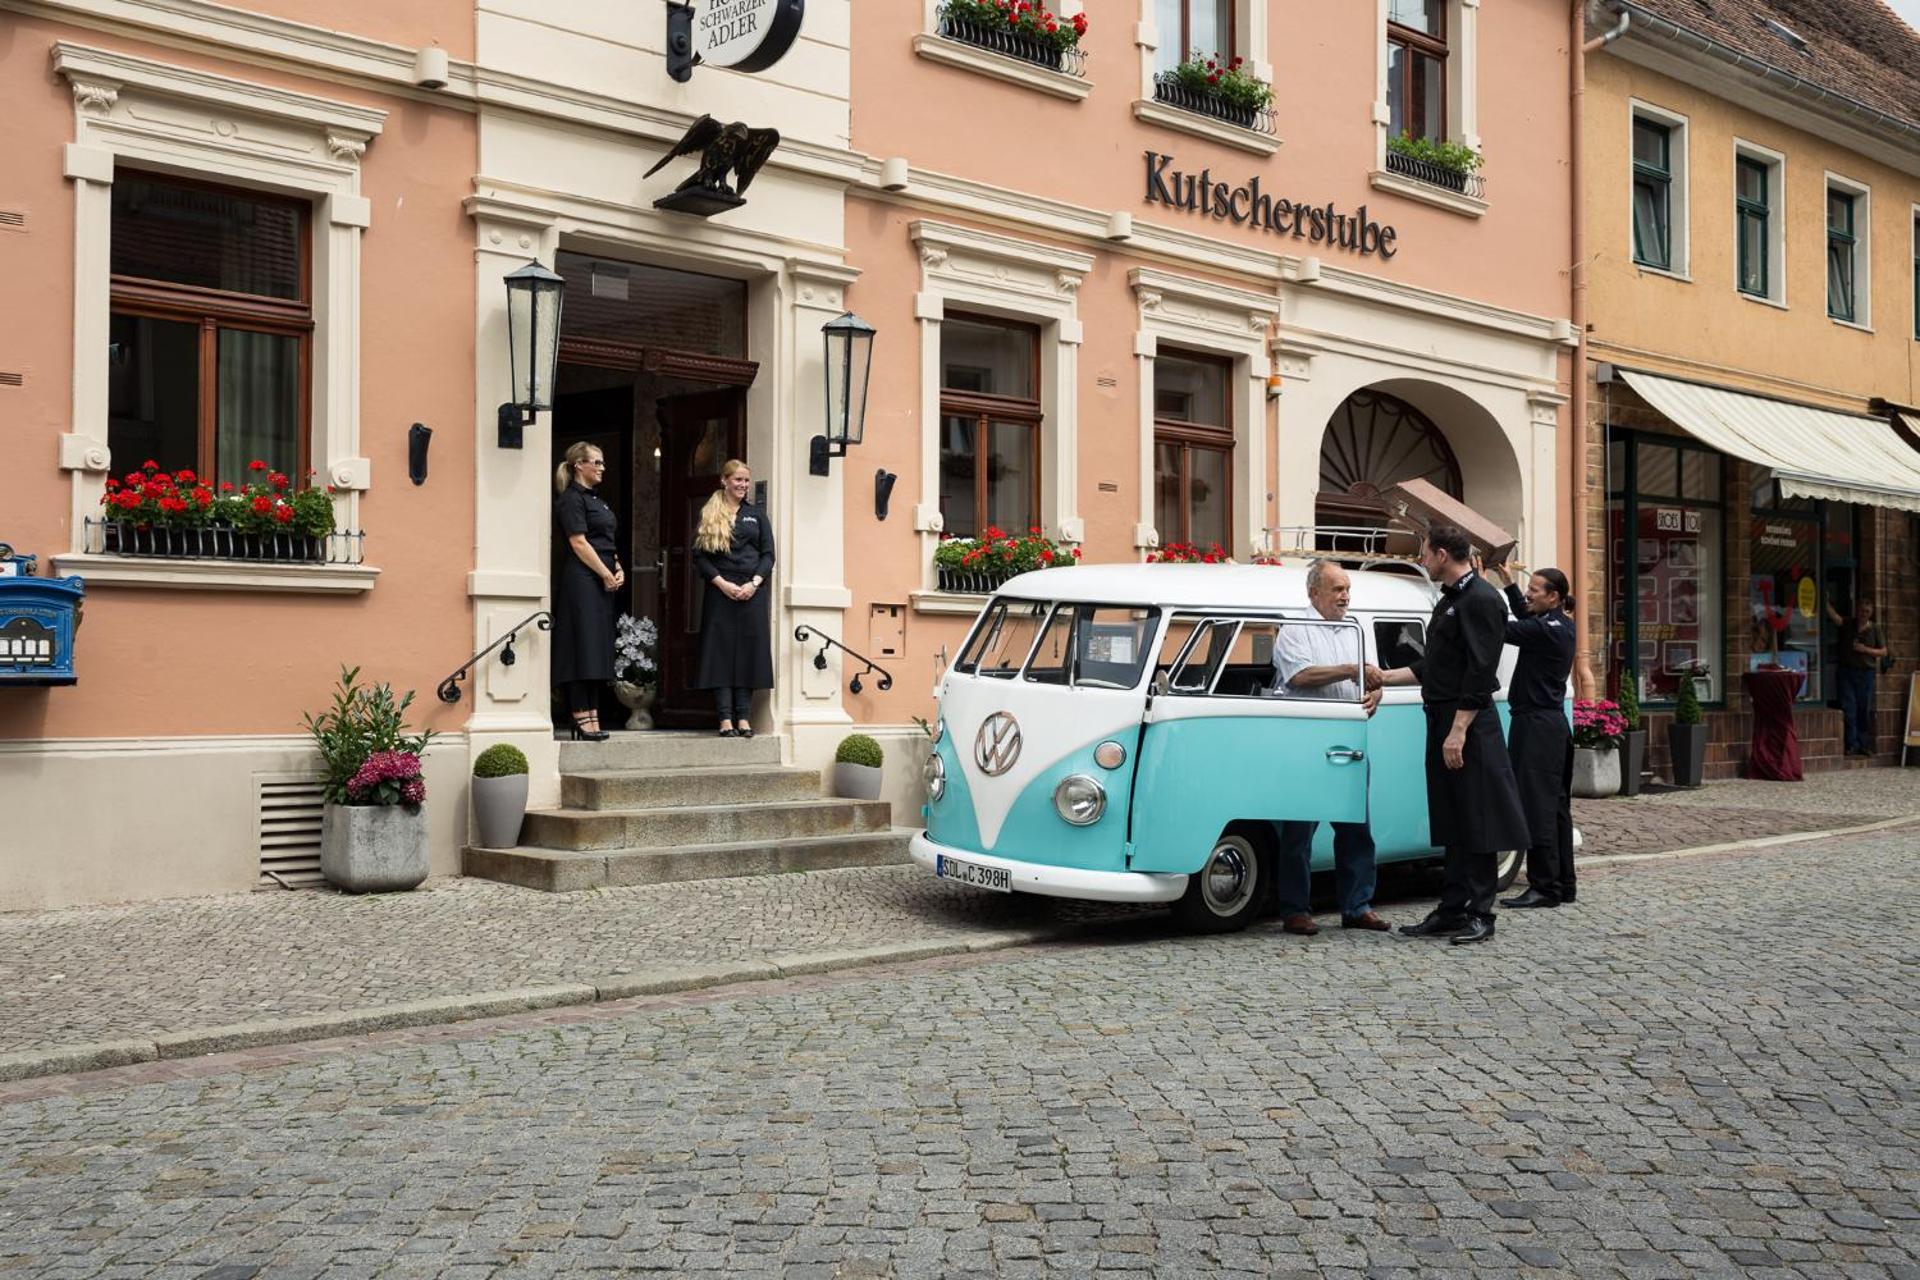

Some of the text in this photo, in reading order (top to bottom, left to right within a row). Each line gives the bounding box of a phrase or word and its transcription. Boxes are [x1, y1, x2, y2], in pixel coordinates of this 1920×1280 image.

[708, 12, 758, 49] ADLER
[1144, 150, 1397, 258] Kutscherstube
[978, 868, 1009, 889] 398H
